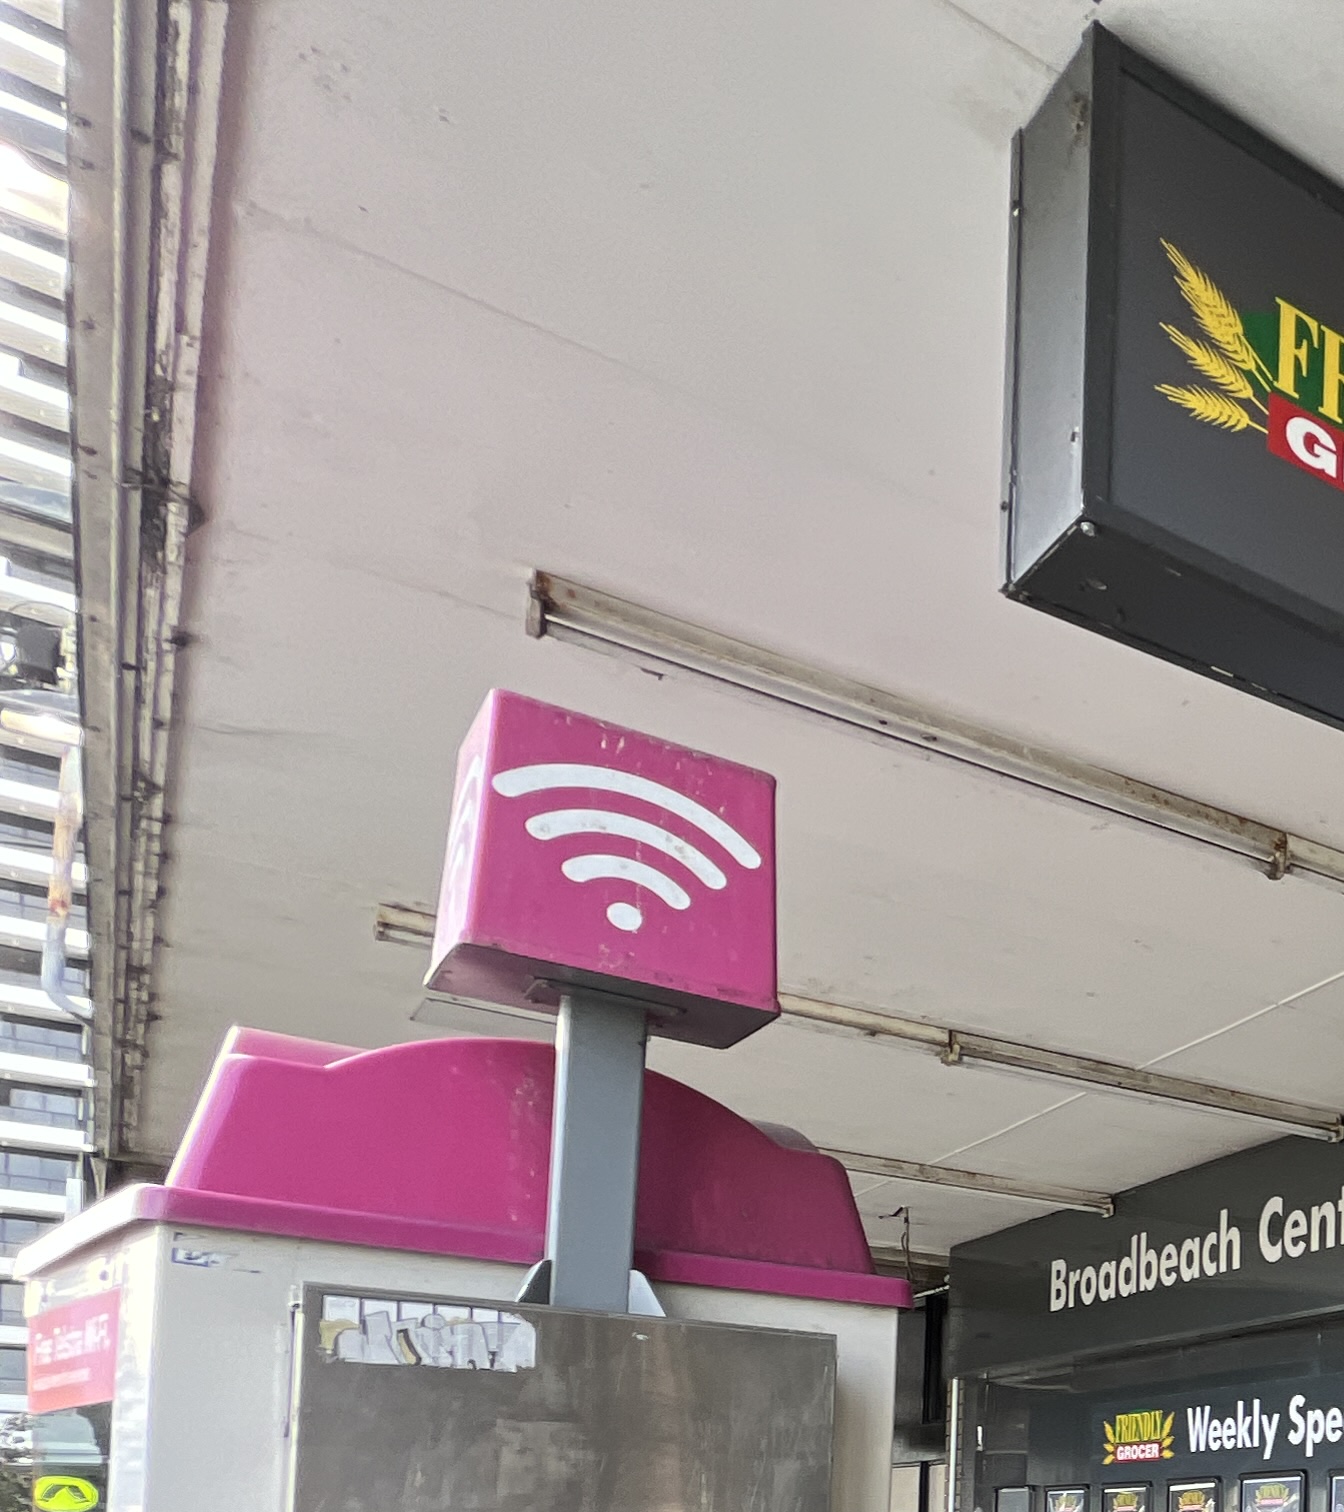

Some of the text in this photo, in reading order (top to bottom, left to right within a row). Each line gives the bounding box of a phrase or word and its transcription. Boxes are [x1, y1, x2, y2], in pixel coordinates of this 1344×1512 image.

[1049, 1209, 1241, 1313] Broadbeach
[1115, 1410, 1163, 1443] FRIENDLY
[1187, 1401, 1280, 1459] Weekly
[1116, 1444, 1159, 1461] GROCER
